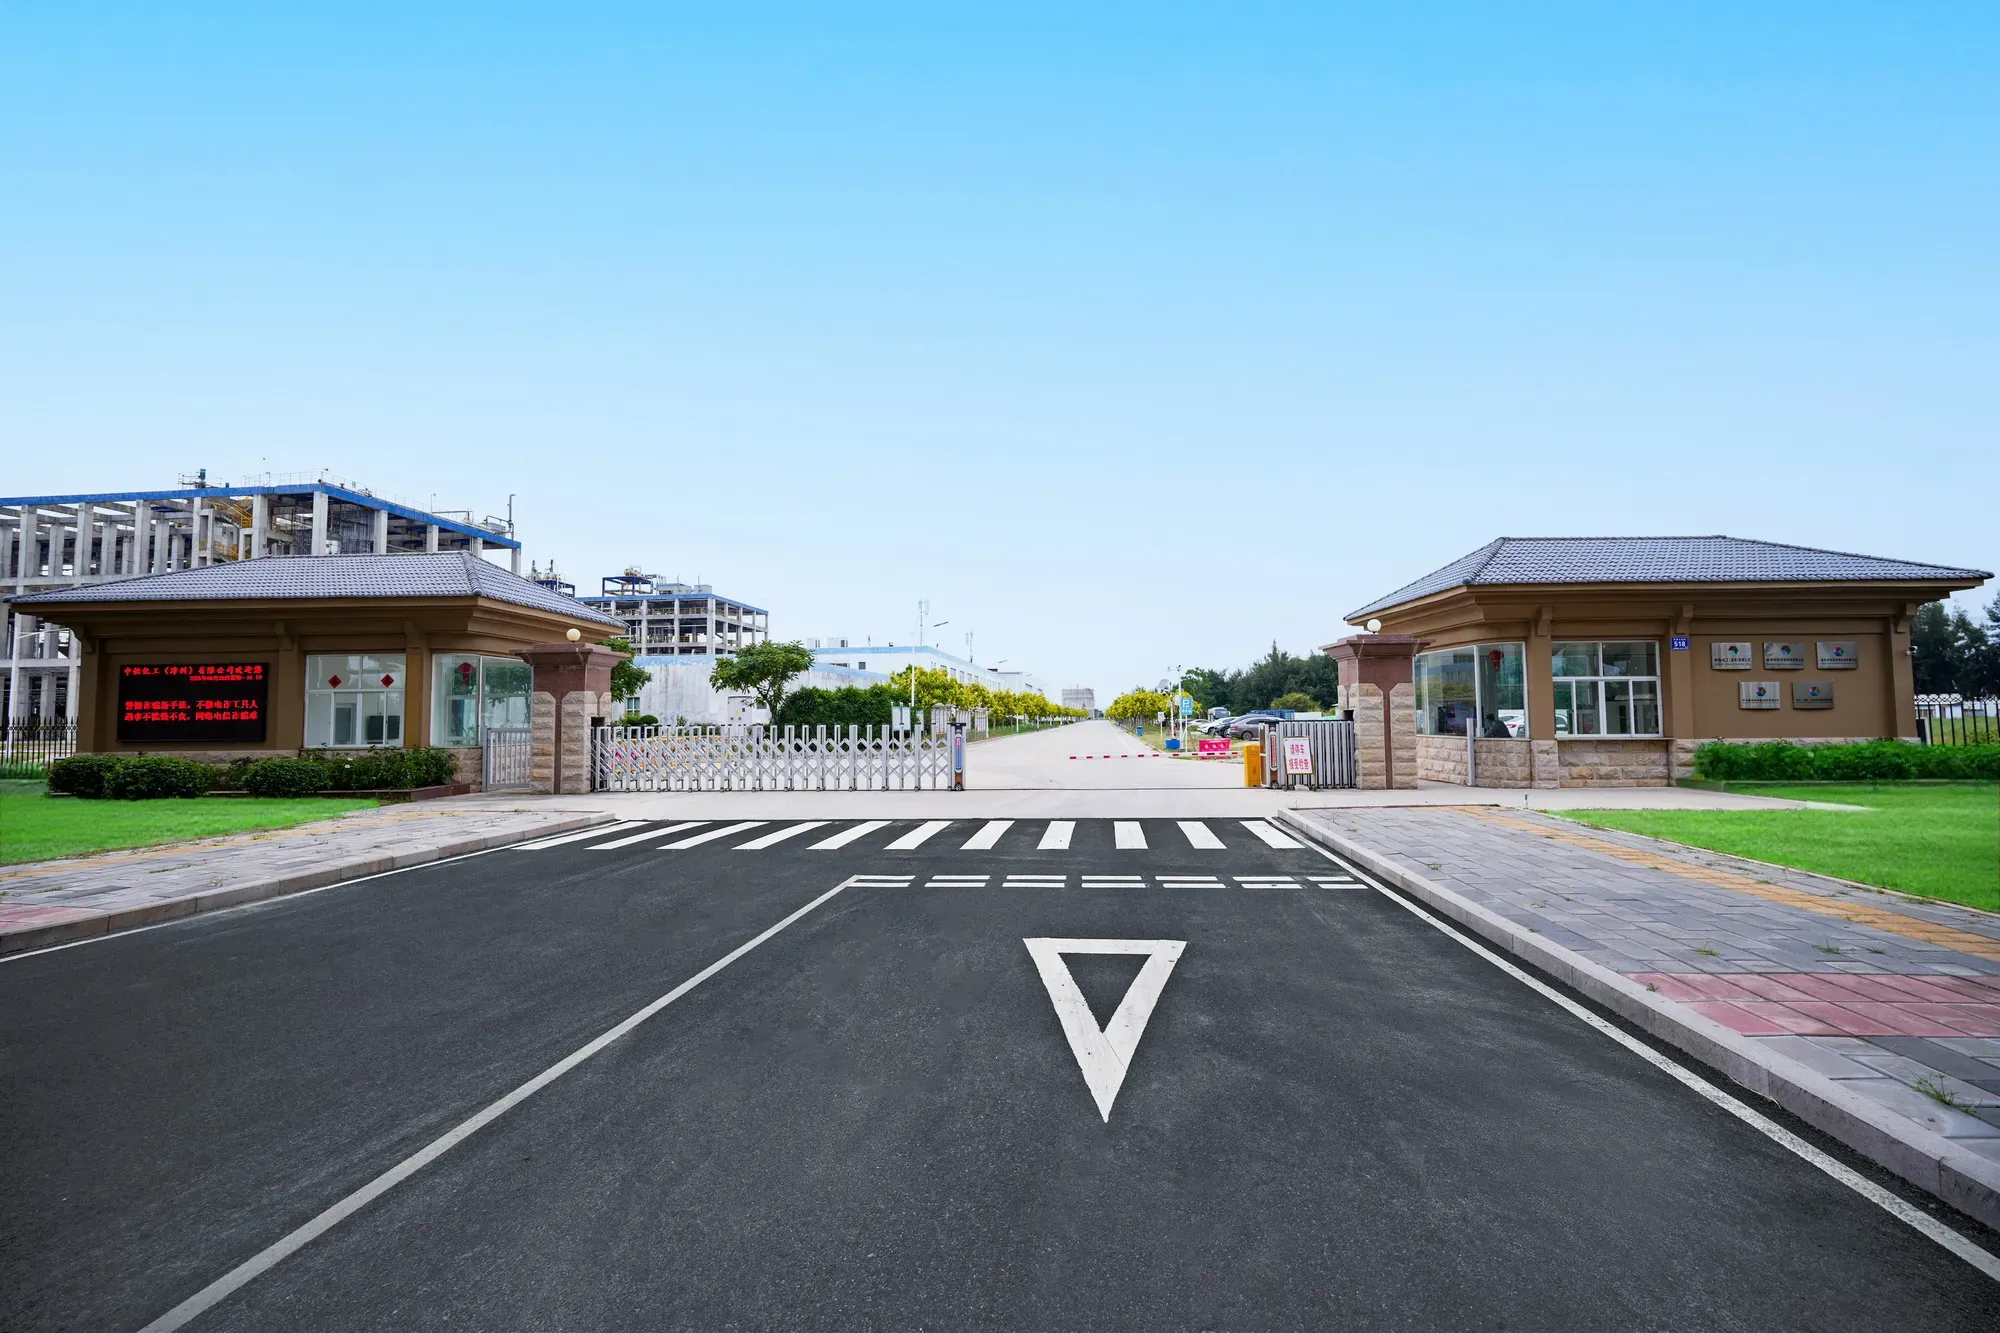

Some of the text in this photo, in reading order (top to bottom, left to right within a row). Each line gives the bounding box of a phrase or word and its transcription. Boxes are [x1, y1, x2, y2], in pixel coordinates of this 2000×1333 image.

[1290, 743, 1305, 755] 请停车
[1288, 758, 1309, 770] 接受检查
